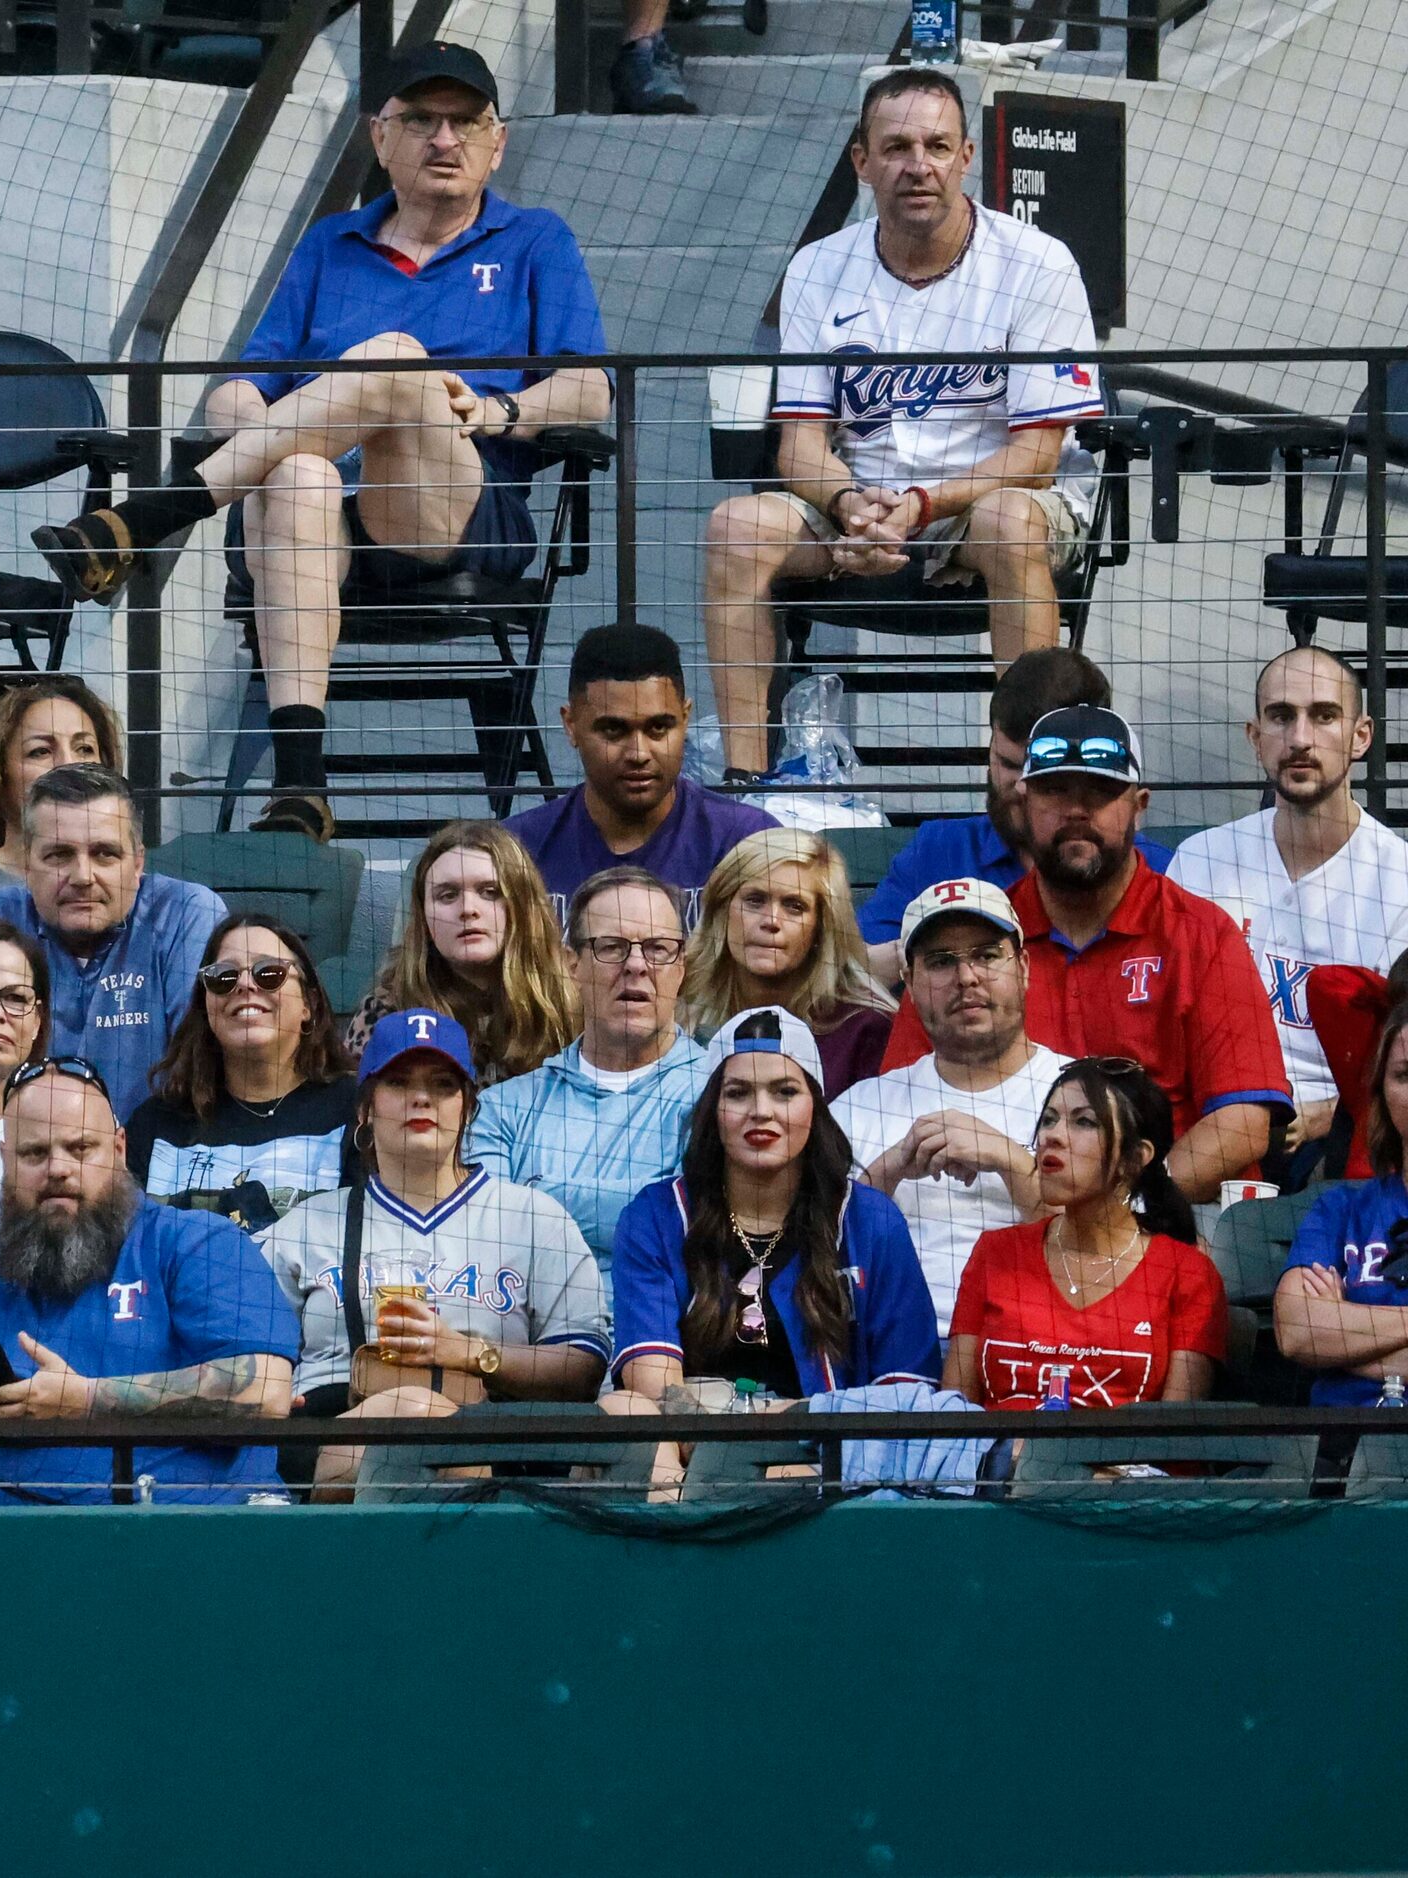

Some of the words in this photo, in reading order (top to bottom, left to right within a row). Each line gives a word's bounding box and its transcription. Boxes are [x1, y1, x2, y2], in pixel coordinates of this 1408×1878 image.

[1012, 126, 1038, 149] Globe
[1038, 128, 1055, 151] Life
[1055, 130, 1076, 152] Field
[1012, 168, 1045, 195] SECTION
[472, 262, 501, 294] T
[933, 881, 970, 905] T
[1121, 956, 1163, 1003] T
[1266, 953, 1320, 1030] X
[95, 1012, 150, 1028] RANGERS
[407, 1014, 437, 1041] T
[107, 1280, 148, 1322] T
[1028, 1341, 1057, 1355] Texas
[1058, 1343, 1103, 1361] Rangers
